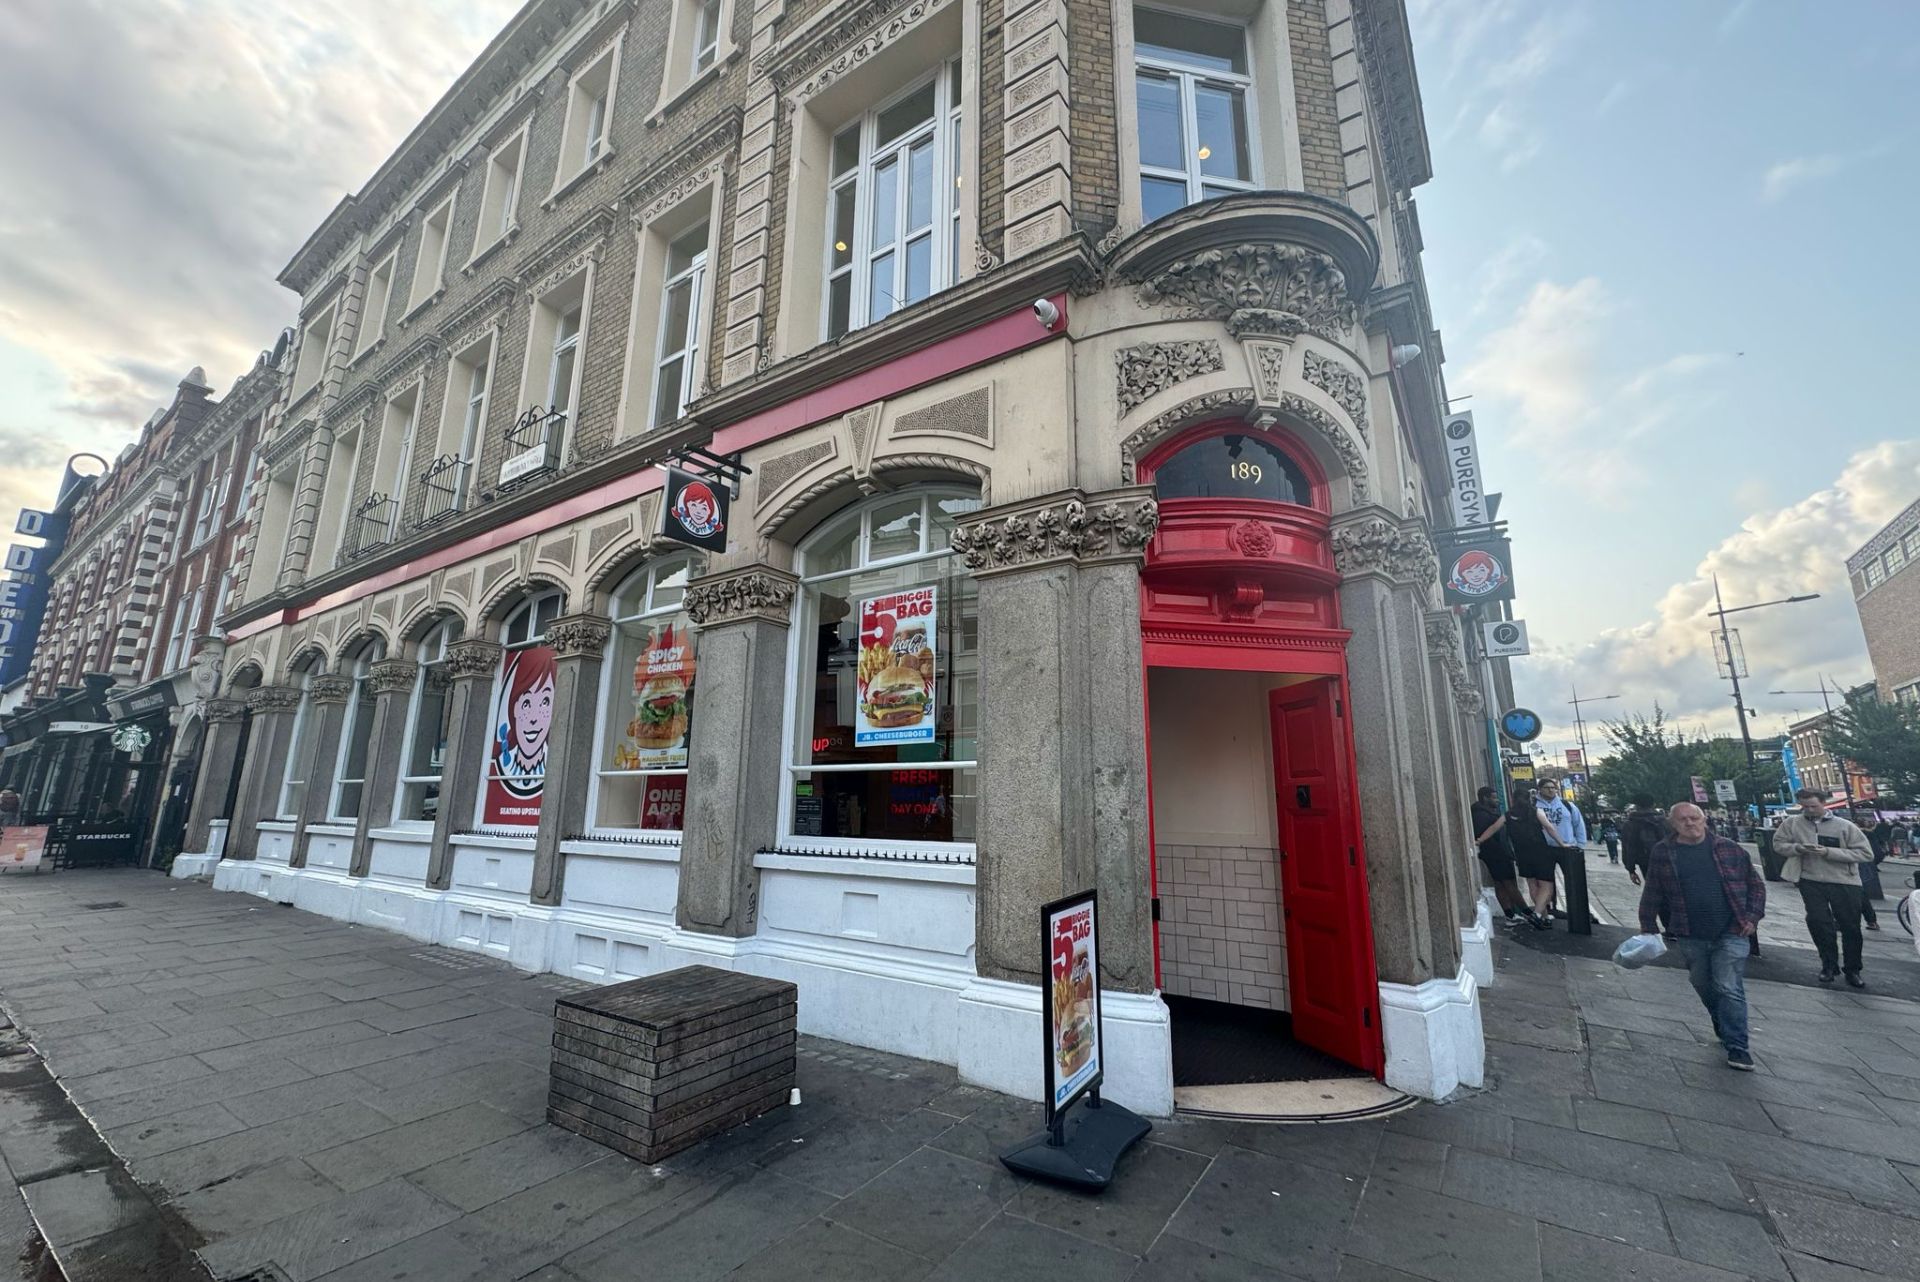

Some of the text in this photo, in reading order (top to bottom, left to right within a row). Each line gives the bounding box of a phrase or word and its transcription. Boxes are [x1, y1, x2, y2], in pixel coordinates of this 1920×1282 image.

[1231, 462, 1262, 484] 189
[1453, 445, 1482, 526] PUREGYM
[897, 589, 934, 605] BIGGIE
[896, 600, 934, 620] BAG
[648, 645, 685, 664] SPICY
[647, 661, 683, 674] CHICKEN
[874, 729, 928, 740] CHEESEBURGER
[1508, 756, 1530, 764] VANS
[892, 769, 939, 784] FRESH
[649, 789, 682, 802] ONE
[522, 807, 541, 815] UPSTAI
[1072, 920, 1090, 943] BAG
